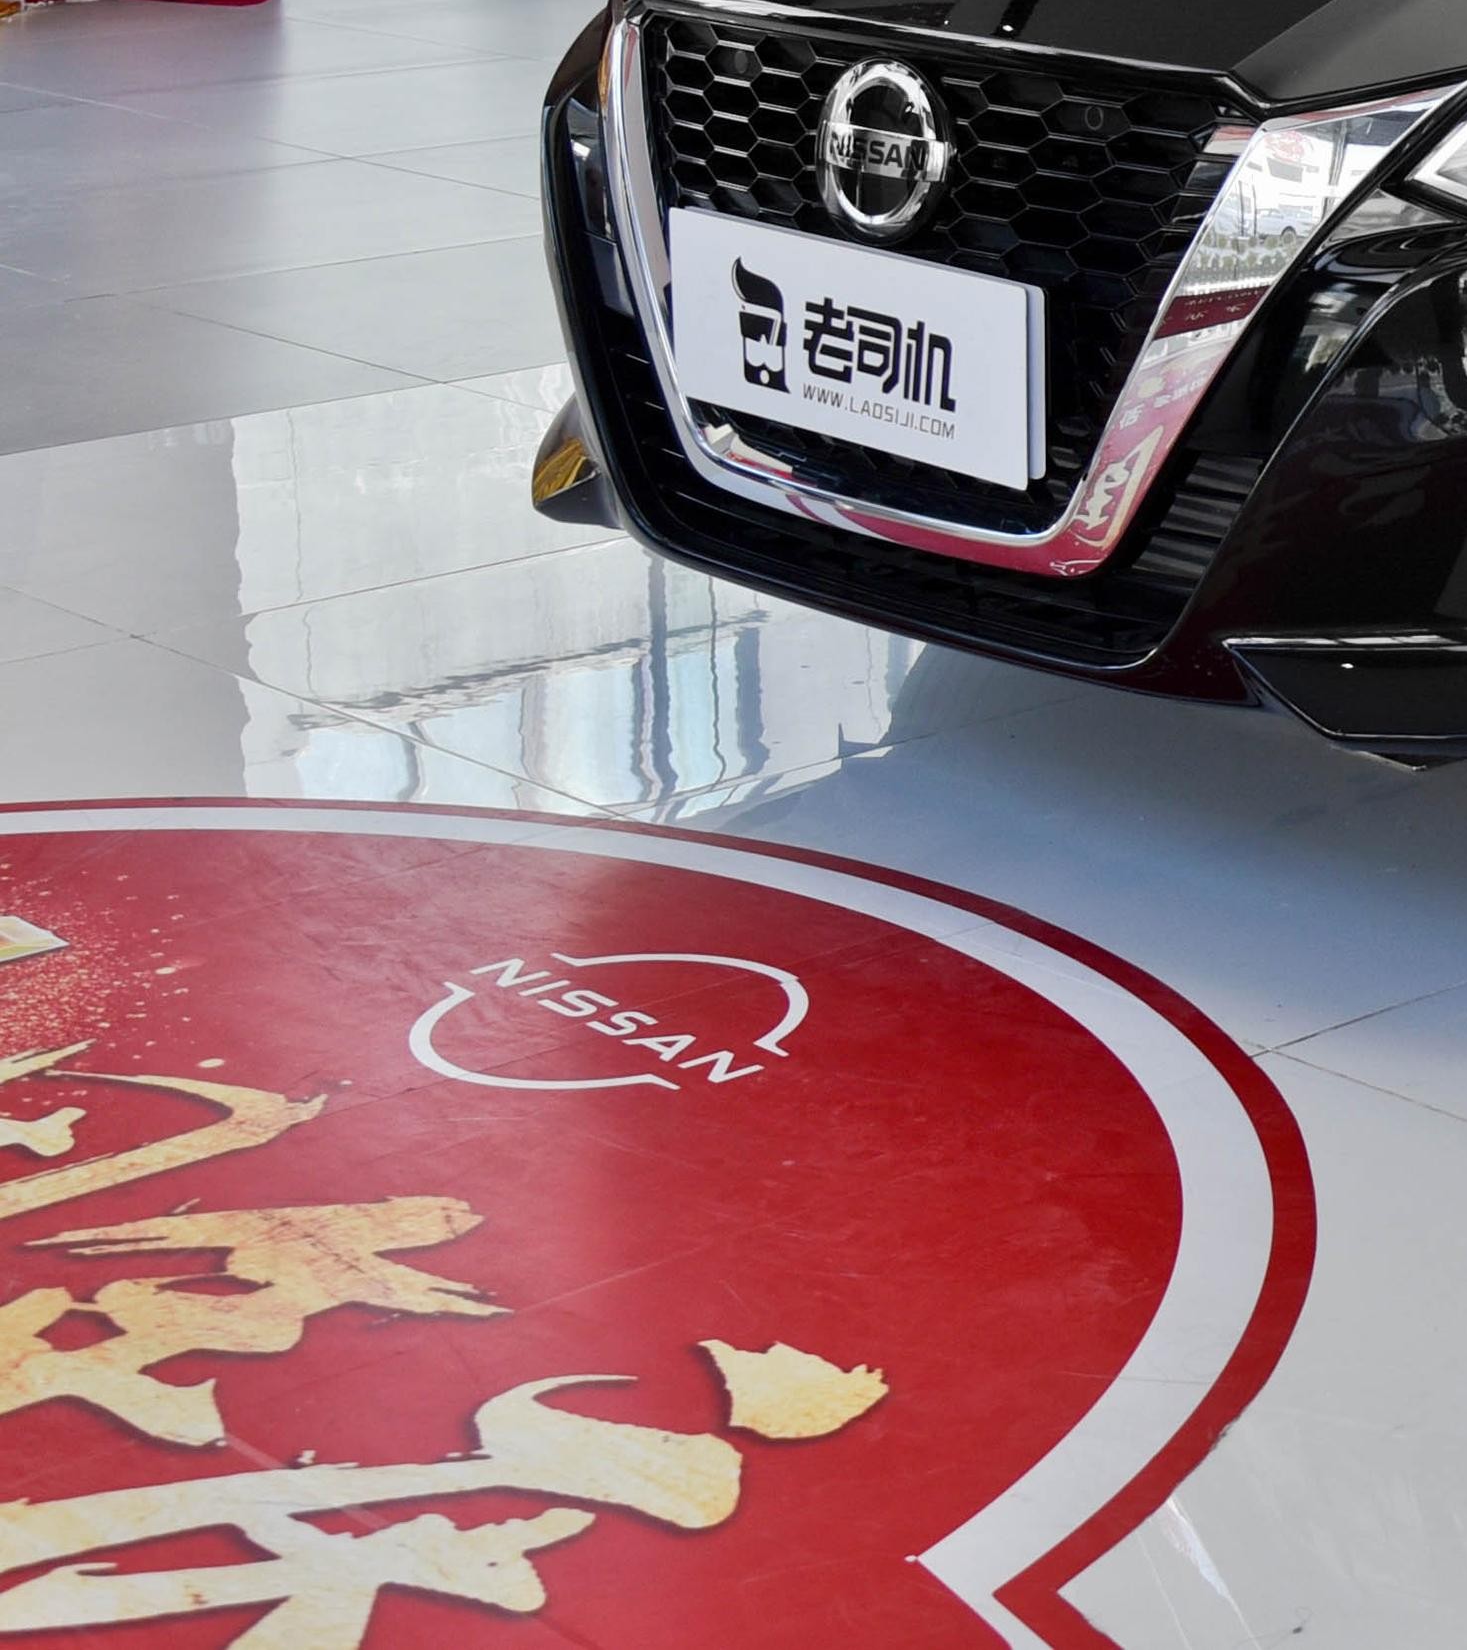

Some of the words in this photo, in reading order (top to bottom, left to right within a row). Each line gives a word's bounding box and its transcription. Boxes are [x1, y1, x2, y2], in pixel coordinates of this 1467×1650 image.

[829, 132, 931, 177] NISSAN
[803, 296, 957, 412] 老司机
[802, 382, 957, 440] WWW.LAOSIJI.COM
[470, 956, 765, 1086] NISSAN
